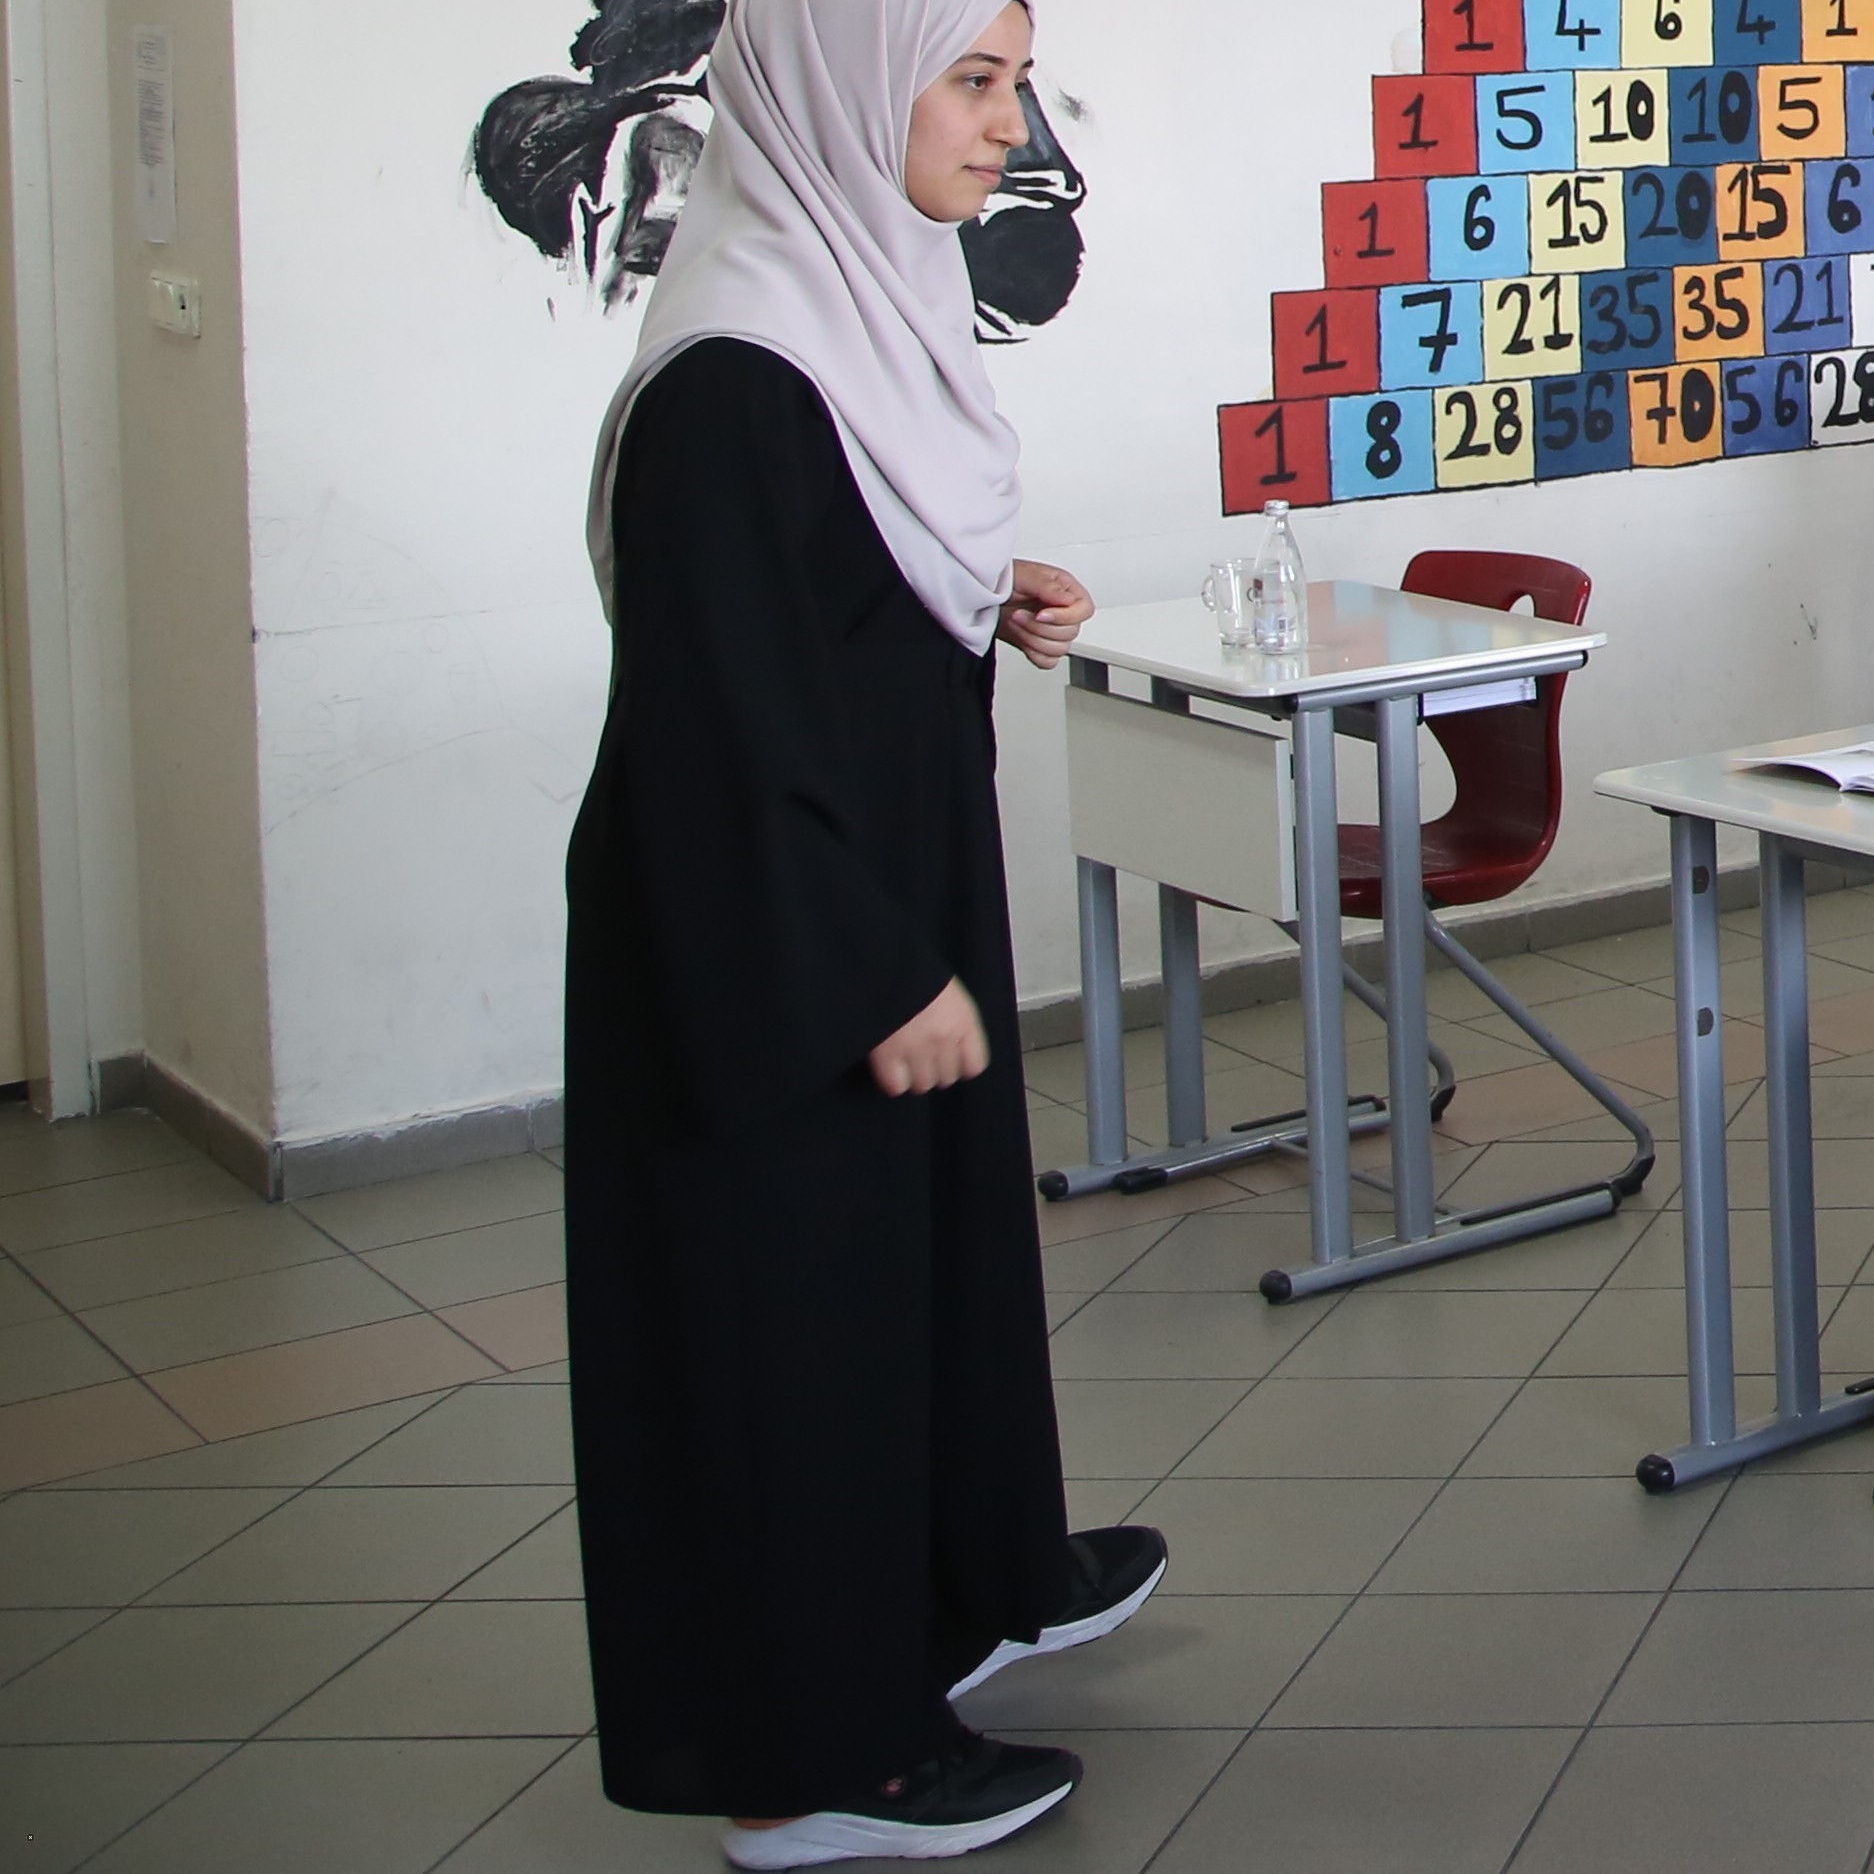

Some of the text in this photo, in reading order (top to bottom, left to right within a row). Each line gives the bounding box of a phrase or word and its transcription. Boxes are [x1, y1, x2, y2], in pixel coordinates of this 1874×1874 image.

[1398, 93, 1438, 150] 1
[1496, 85, 1547, 149] 5
[1589, 81, 1656, 143] 10
[1687, 79, 1751, 144] 10
[1778, 77, 1821, 140] 5
[1355, 202, 1395, 258] 1
[1465, 182, 1495, 248] 6
[1547, 180, 1611, 247] 15
[1640, 168, 1711, 238] 20
[1722, 163, 1792, 242] 15
[1828, 165, 1862, 234] 6
[1304, 308, 1347, 372] 1
[1401, 291, 1458, 372] 7
[1496, 285, 1574, 355] 21
[1587, 280, 1663, 352] 35
[1682, 274, 1749, 344] 35
[1774, 277, 1845, 332] 21
[1254, 408, 1299, 485] 1
[1366, 400, 1400, 479] 8
[1444, 391, 1522, 459] 28
[1543, 384, 1614, 451] 56
[1644, 371, 1714, 443] 70
[1728, 366, 1799, 434] 56
